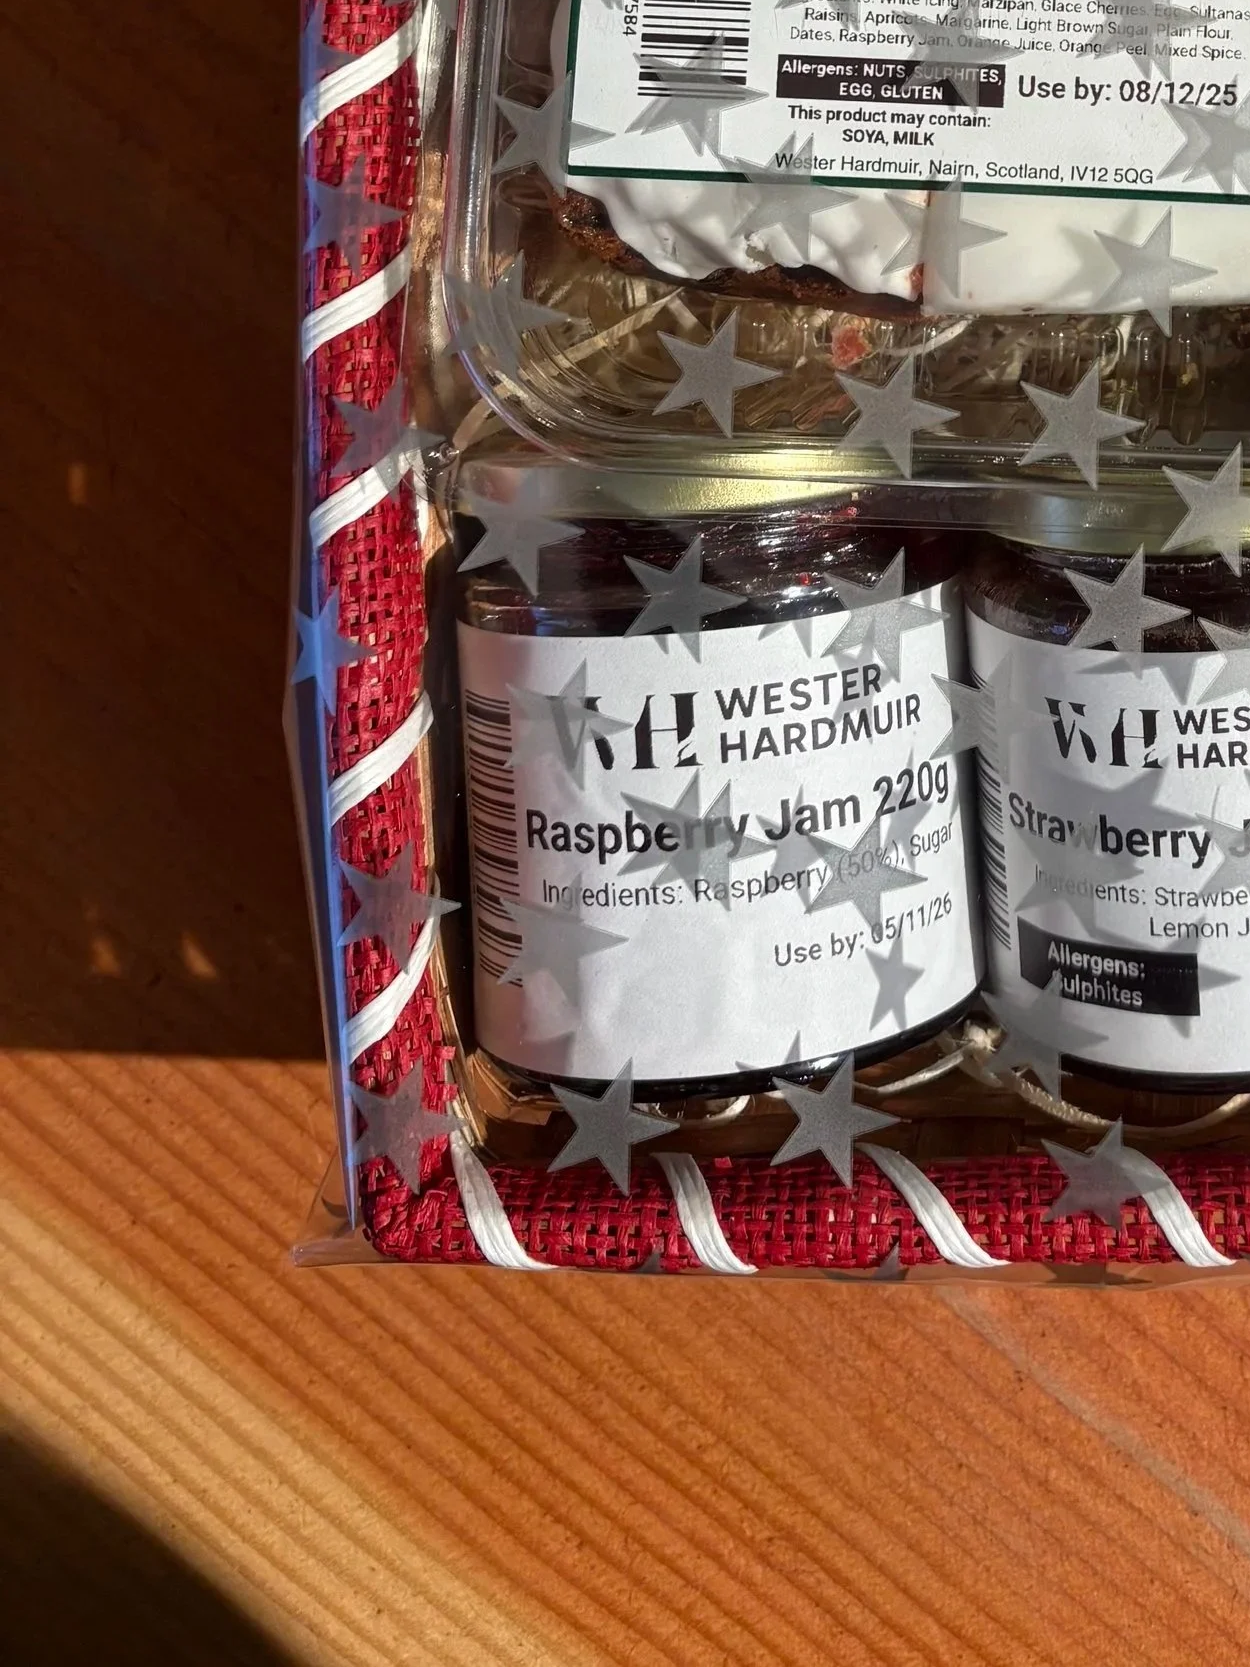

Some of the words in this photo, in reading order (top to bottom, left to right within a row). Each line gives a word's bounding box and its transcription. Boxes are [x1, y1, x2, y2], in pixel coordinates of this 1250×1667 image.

[839, 29, 915, 48] Raspberry
[1059, 39, 1112, 55] Orange
[1154, 42, 1198, 58] Mixed
[1016, 17, 1052, 34] Light
[1056, 19, 1104, 35] Brown
[1156, 23, 1192, 39] Plain
[781, 60, 859, 78] Allergens:
[862, 63, 910, 80] NUTS,
[913, 67, 1002, 86] SULPHITES,
[839, 83, 876, 100] EGG,
[880, 84, 943, 100] GLUTEN
[1018, 75, 1066, 99] Use
[1074, 77, 1112, 106] by:
[1118, 79, 1239, 107] 08/12/25
[788, 104, 822, 120] This
[825, 107, 887, 125] product
[890, 113, 924, 129] may
[928, 112, 992, 128] contain:
[842, 129, 889, 147] SOYA,
[893, 130, 935, 146] MILK
[775, 152, 836, 171] Wester
[840, 155, 923, 176] Hardmuir,
[928, 159, 980, 178] Nairn,
[985, 162, 1064, 182] Scotland,
[1070, 165, 1108, 183] IV12
[1113, 168, 1154, 184] 5QG
[714, 663, 882, 720] WESTER
[719, 694, 922, 765] HARDMUIR
[526, 808, 750, 866] Raspberry
[763, 792, 863, 842] Jam
[872, 759, 950, 819] 220g
[1006, 791, 1211, 870] Strawberry
[542, 879, 684, 912] Ingredients:
[693, 864, 829, 905] Raspberry
[835, 839, 906, 886] (50%),
[909, 822, 955, 857] Sugar
[773, 942, 823, 968] Use
[830, 930, 866, 961] by:
[870, 893, 954, 944] 05/11/26
[1149, 916, 1229, 940] Lemon
[1047, 940, 1146, 979] Allergens:
